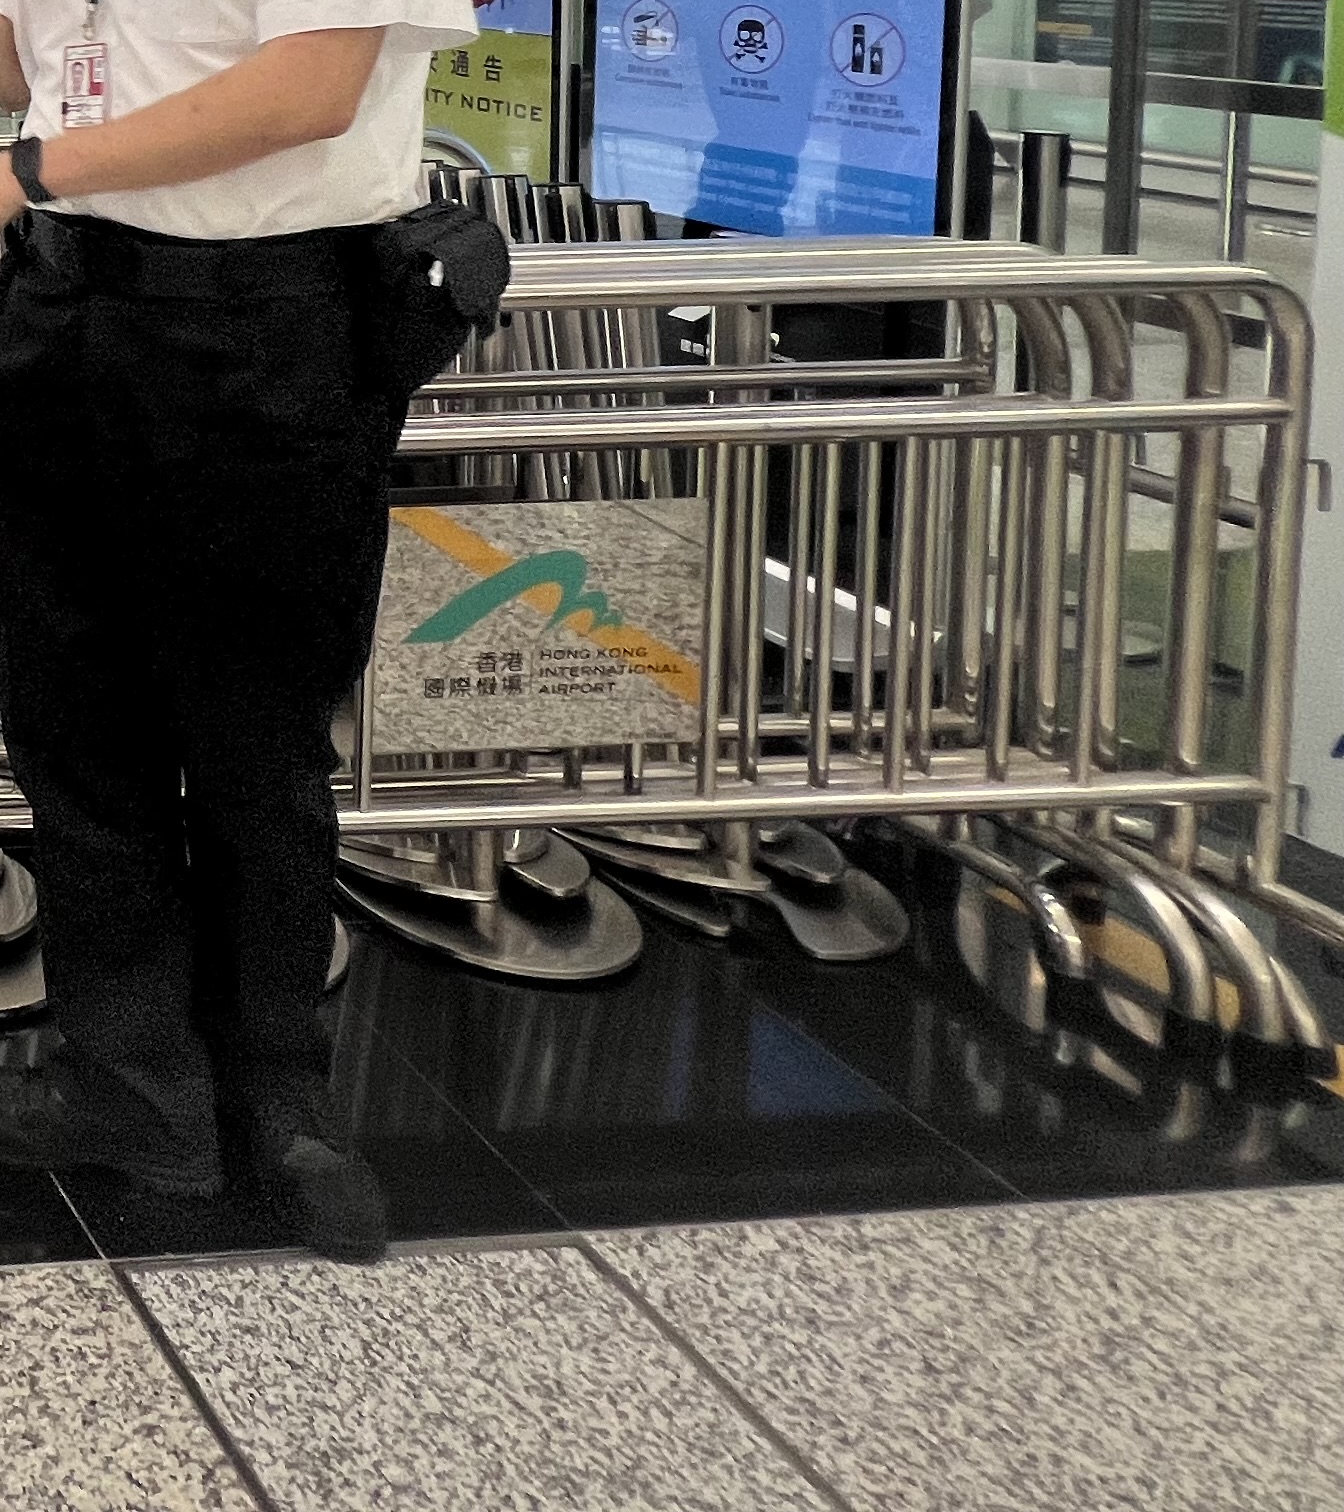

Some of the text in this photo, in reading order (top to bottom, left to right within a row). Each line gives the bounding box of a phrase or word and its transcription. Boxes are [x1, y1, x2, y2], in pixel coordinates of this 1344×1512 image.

[461, 93, 544, 123] NOTICE
[540, 647, 648, 660] HONG KONG
[475, 650, 524, 674] 香港
[540, 663, 683, 677] INTERNATIONAL
[539, 682, 616, 695] AIRPORT
